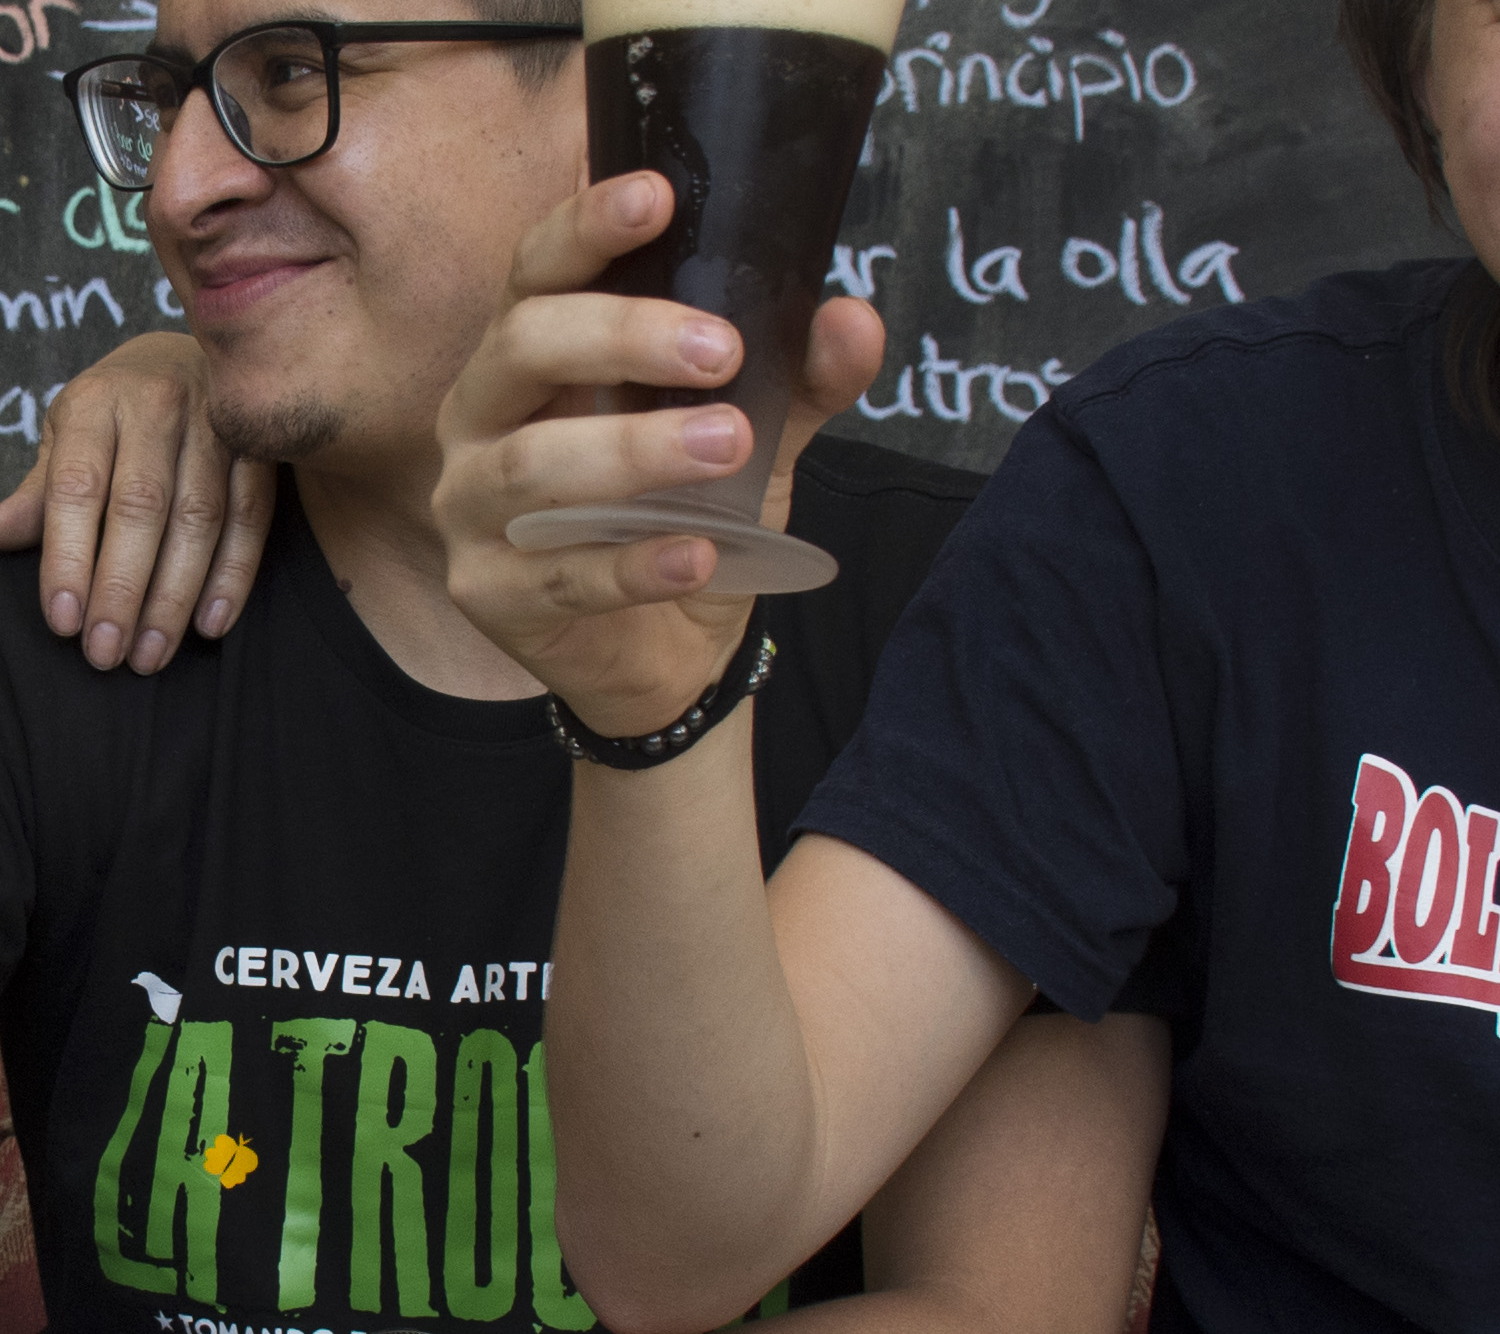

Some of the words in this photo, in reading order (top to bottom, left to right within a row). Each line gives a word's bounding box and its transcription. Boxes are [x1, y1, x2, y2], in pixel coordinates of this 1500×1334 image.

[948, 206, 1029, 305] la
[1061, 199, 1245, 306] olla
[214, 946, 431, 1001] CERVEZA
[94, 1019, 234, 1314] LA
[272, 1017, 602, 1333] TROC
